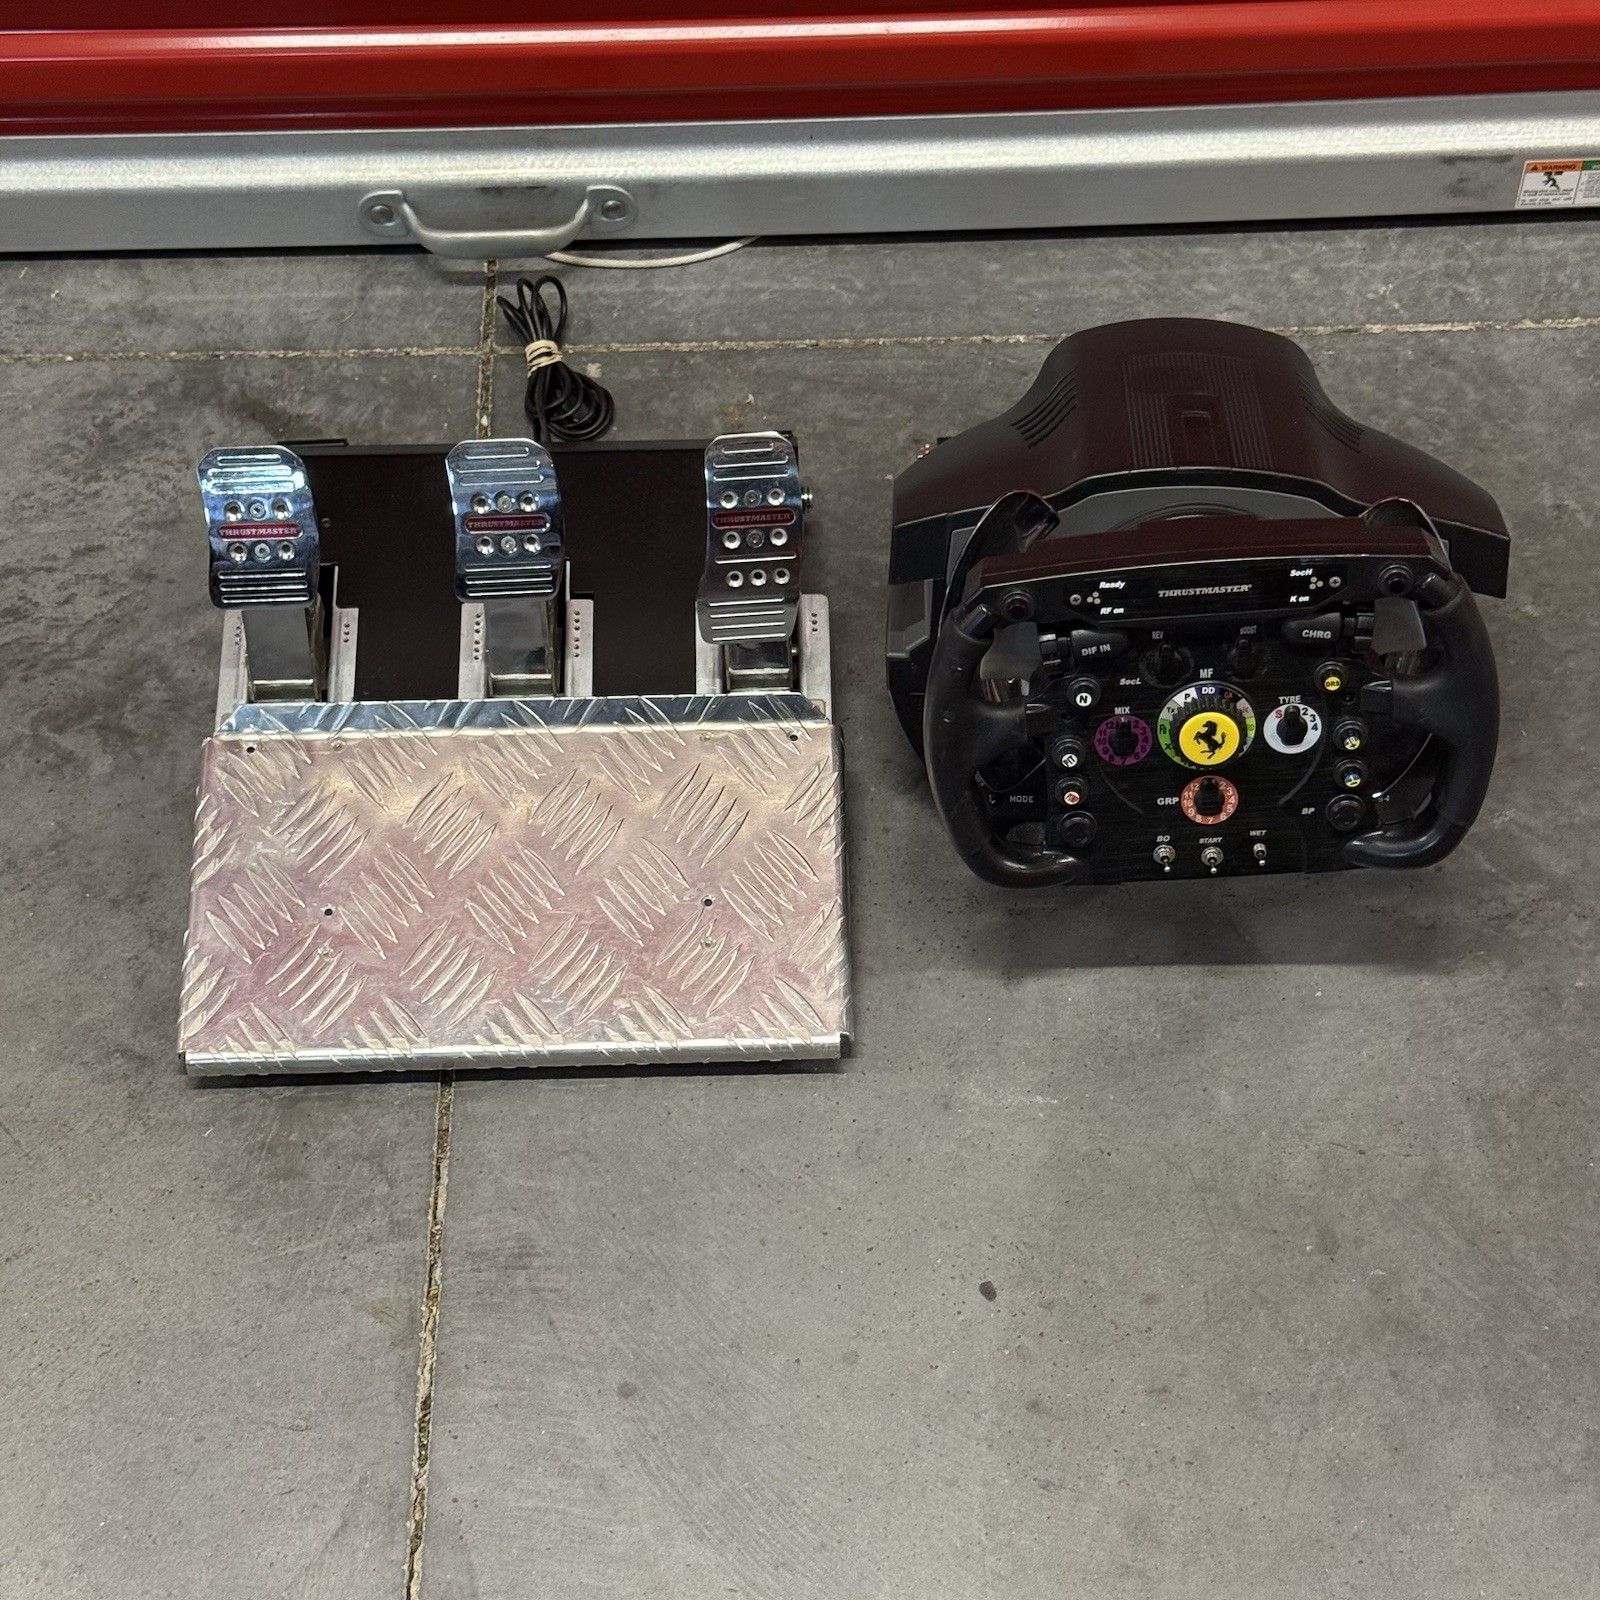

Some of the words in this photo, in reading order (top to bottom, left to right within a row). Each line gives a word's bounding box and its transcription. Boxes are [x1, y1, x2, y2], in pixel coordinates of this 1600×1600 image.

[715, 513, 791, 523] THRUSTMASTER
[467, 519, 545, 528] THRUSTMASTER
[219, 527, 297, 536] THRUSTMASTER
[1290, 568, 1313, 577] SocH
[1100, 580, 1126, 590] Ready
[1158, 584, 1252, 597] THRUSTMASTER
[1240, 625, 1257, 635] BOOST
[1302, 629, 1332, 639] CHRG
[1152, 630, 1164, 640] REV
[1081, 645, 1098, 657] DIF
[1099, 643, 1111, 653] IN
[1199, 668, 1214, 679] MF
[1119, 677, 1142, 686] SocL
[1202, 686, 1215, 695] DD
[1080, 695, 1088, 704] N
[1184, 693, 1191, 701] P
[1278, 695, 1302, 704] TYRE
[1114, 706, 1130, 715] MIX
[1274, 709, 1283, 718] S
[1301, 707, 1308, 716] 2
[1309, 714, 1316, 722] 3
[1105, 721, 1115, 729] 12
[1133, 720, 1140, 728] 2
[1311, 723, 1318, 732] 4
[1140, 727, 1147, 735] 3
[1097, 737, 1106, 745] 10
[1133, 752, 1140, 760] 6
[1063, 755, 1077, 767] PIT
[1189, 782, 1200, 791] 12
[1219, 781, 1227, 790] 2
[1184, 791, 1193, 799] 11
[1226, 786, 1234, 796] 3
[1009, 795, 1034, 803] MODE
[1157, 796, 1179, 805] GRP
[1228, 796, 1236, 804] 4
[1183, 800, 1193, 808] 10
[1226, 804, 1234, 812] 5
[1187, 808, 1195, 817] 9
[1301, 807, 1315, 815] BP
[1195, 814, 1203, 823] 8
[1206, 816, 1214, 825] 7
[1219, 812, 1227, 821] 6
[1156, 835, 1170, 843] BO
